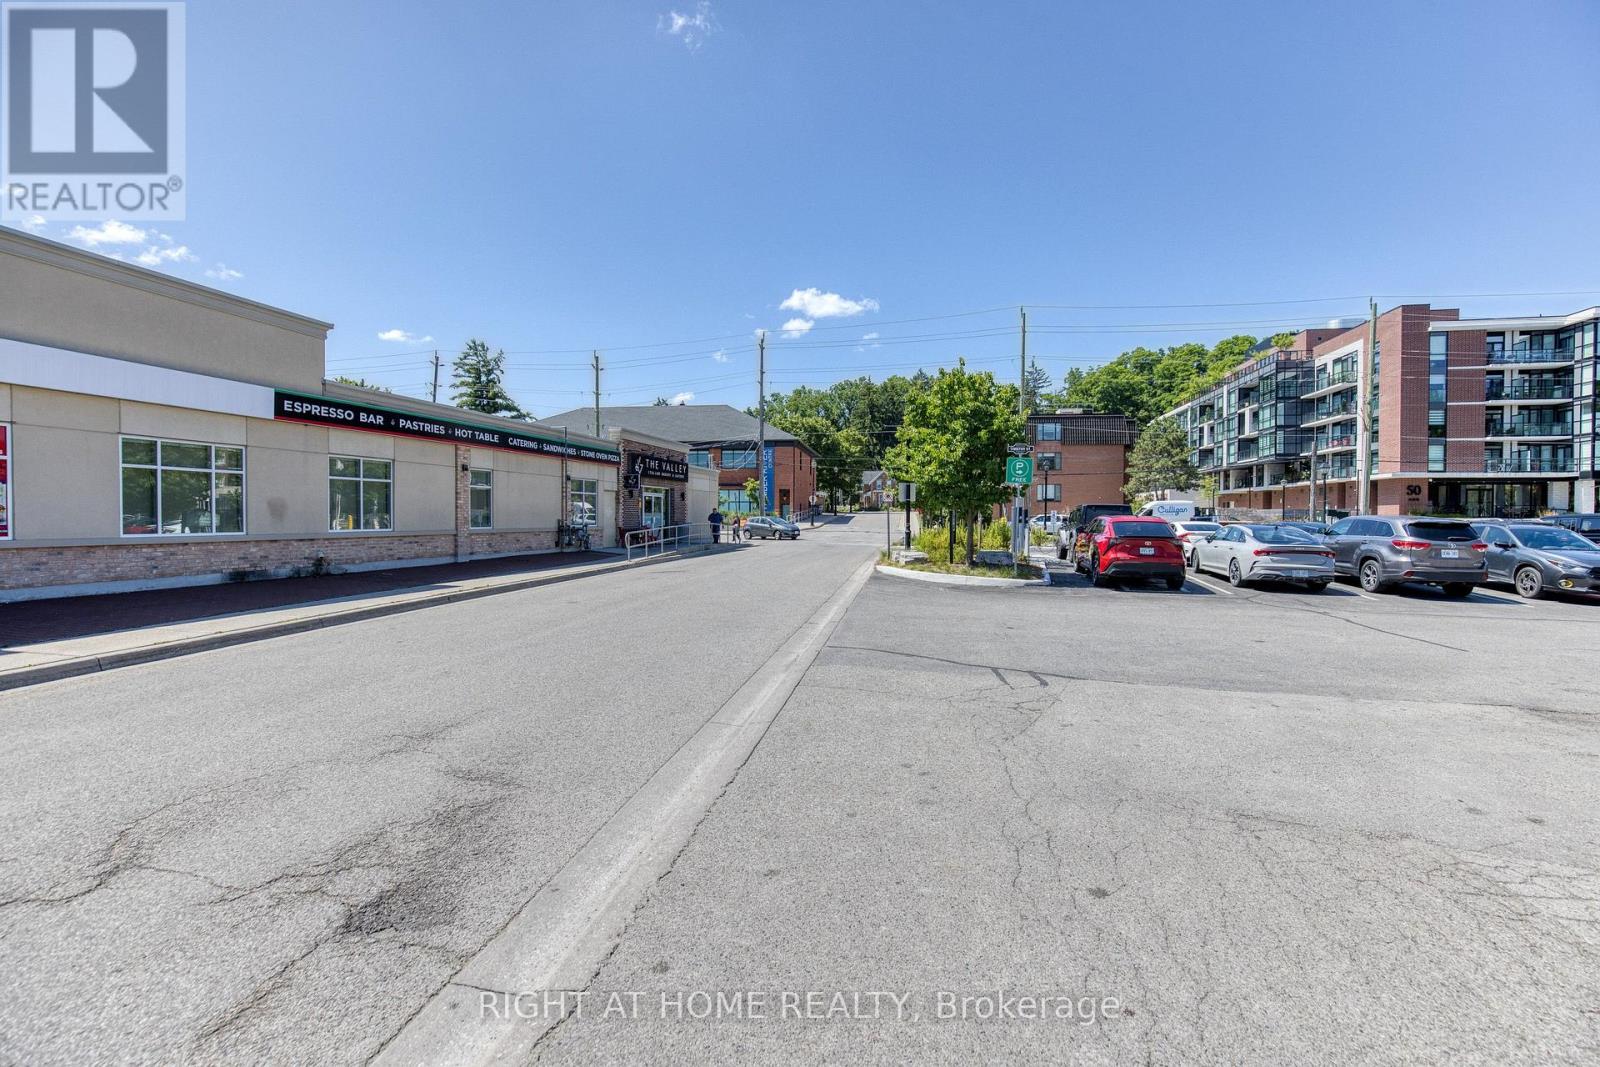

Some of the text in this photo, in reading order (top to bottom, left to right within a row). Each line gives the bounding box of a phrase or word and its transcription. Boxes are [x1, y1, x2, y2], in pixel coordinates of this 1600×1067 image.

[283, 400, 620, 462] ESPRESSO BAR PASTRIES HOT TABLE CATERING SANDWICHES STONE OVEN PIZZA
[646, 459, 687, 473] THE VALLEY
[1016, 462, 1024, 471] P
[1406, 484, 1422, 496] 50
[1157, 505, 1188, 516] Culligan
